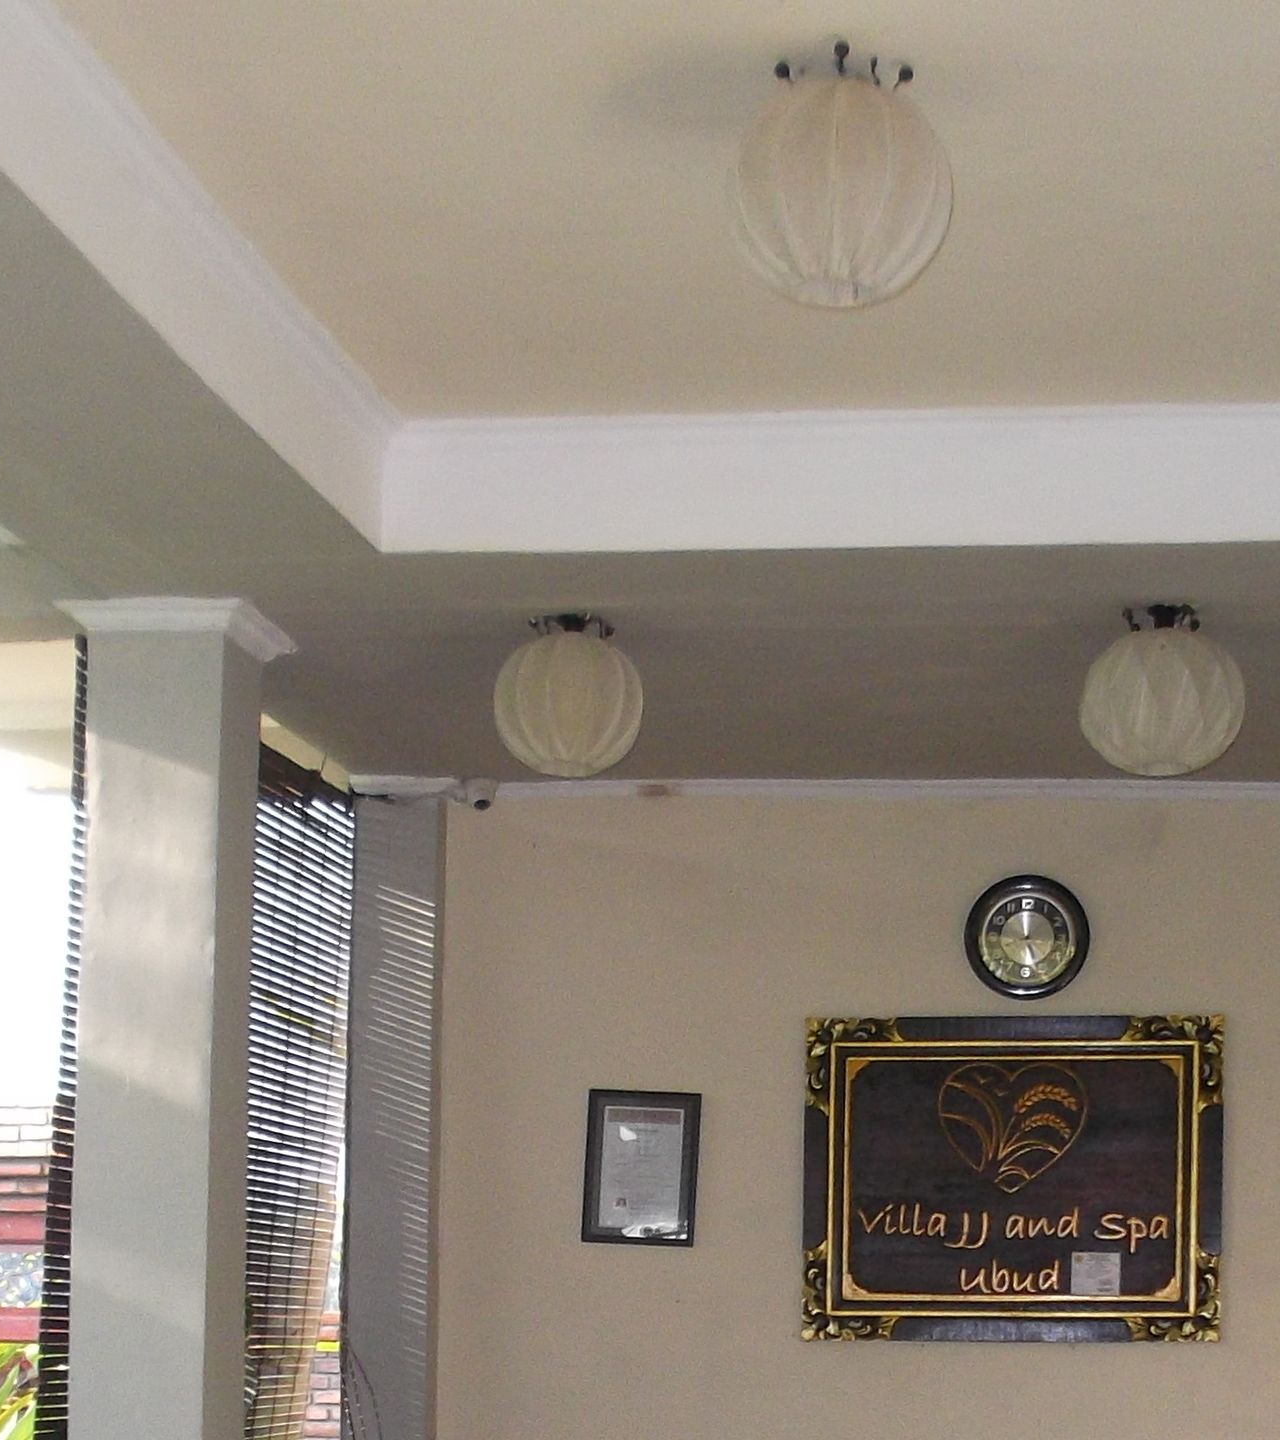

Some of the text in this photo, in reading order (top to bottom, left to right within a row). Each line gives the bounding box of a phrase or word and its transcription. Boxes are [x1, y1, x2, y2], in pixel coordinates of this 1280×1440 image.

[944, 1211, 991, 1249] JJ
[1004, 1206, 1080, 1239] and
[1093, 1213, 1170, 1254] Spa
